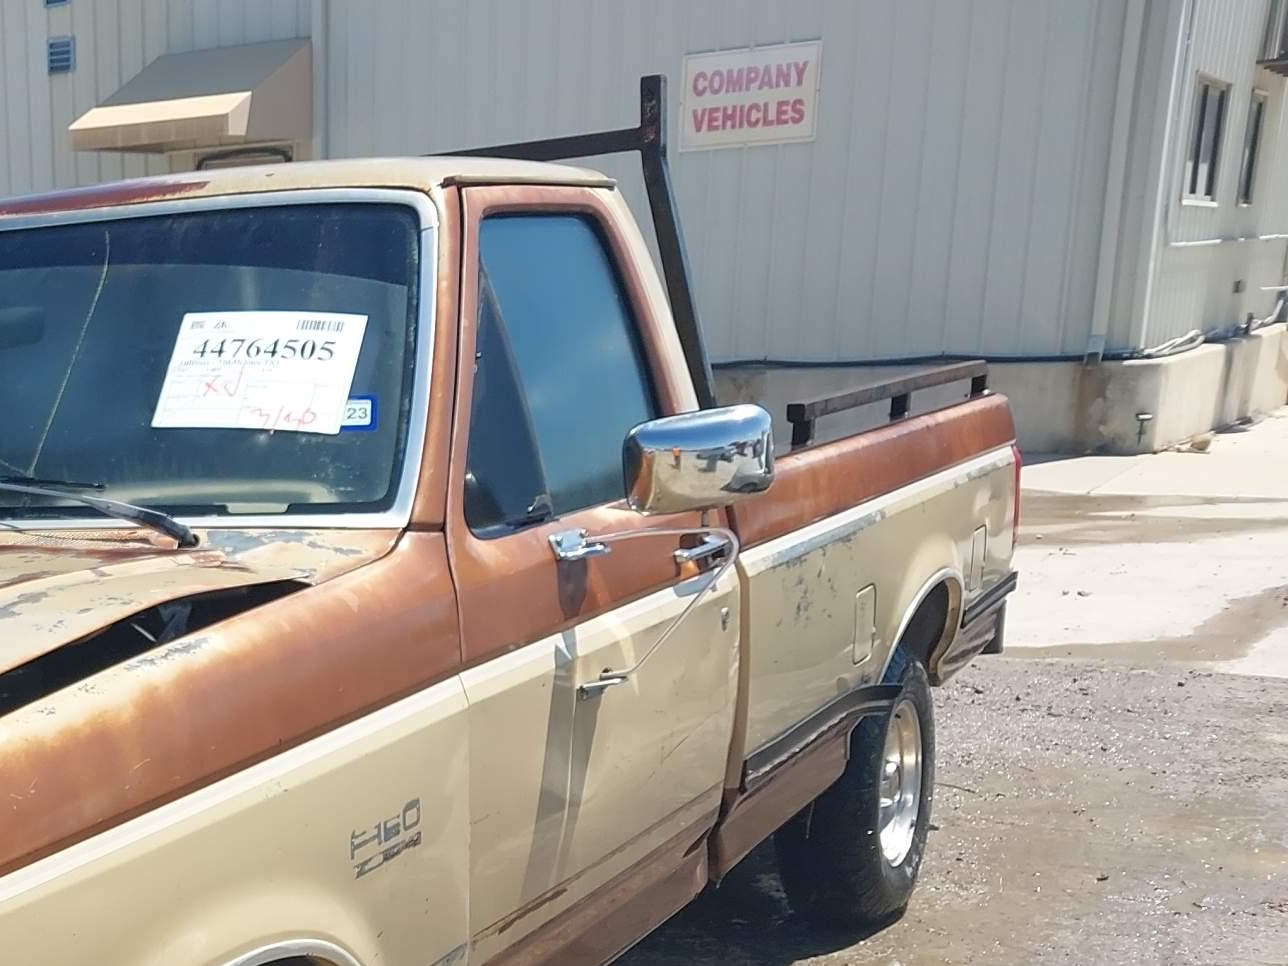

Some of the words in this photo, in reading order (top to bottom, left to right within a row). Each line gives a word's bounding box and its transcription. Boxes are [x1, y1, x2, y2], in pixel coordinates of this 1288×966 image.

[692, 60, 809, 97] COMPANY
[692, 98, 805, 133] VEHICLES
[193, 338, 336, 361] 44764505
[347, 407, 368, 419] 23
